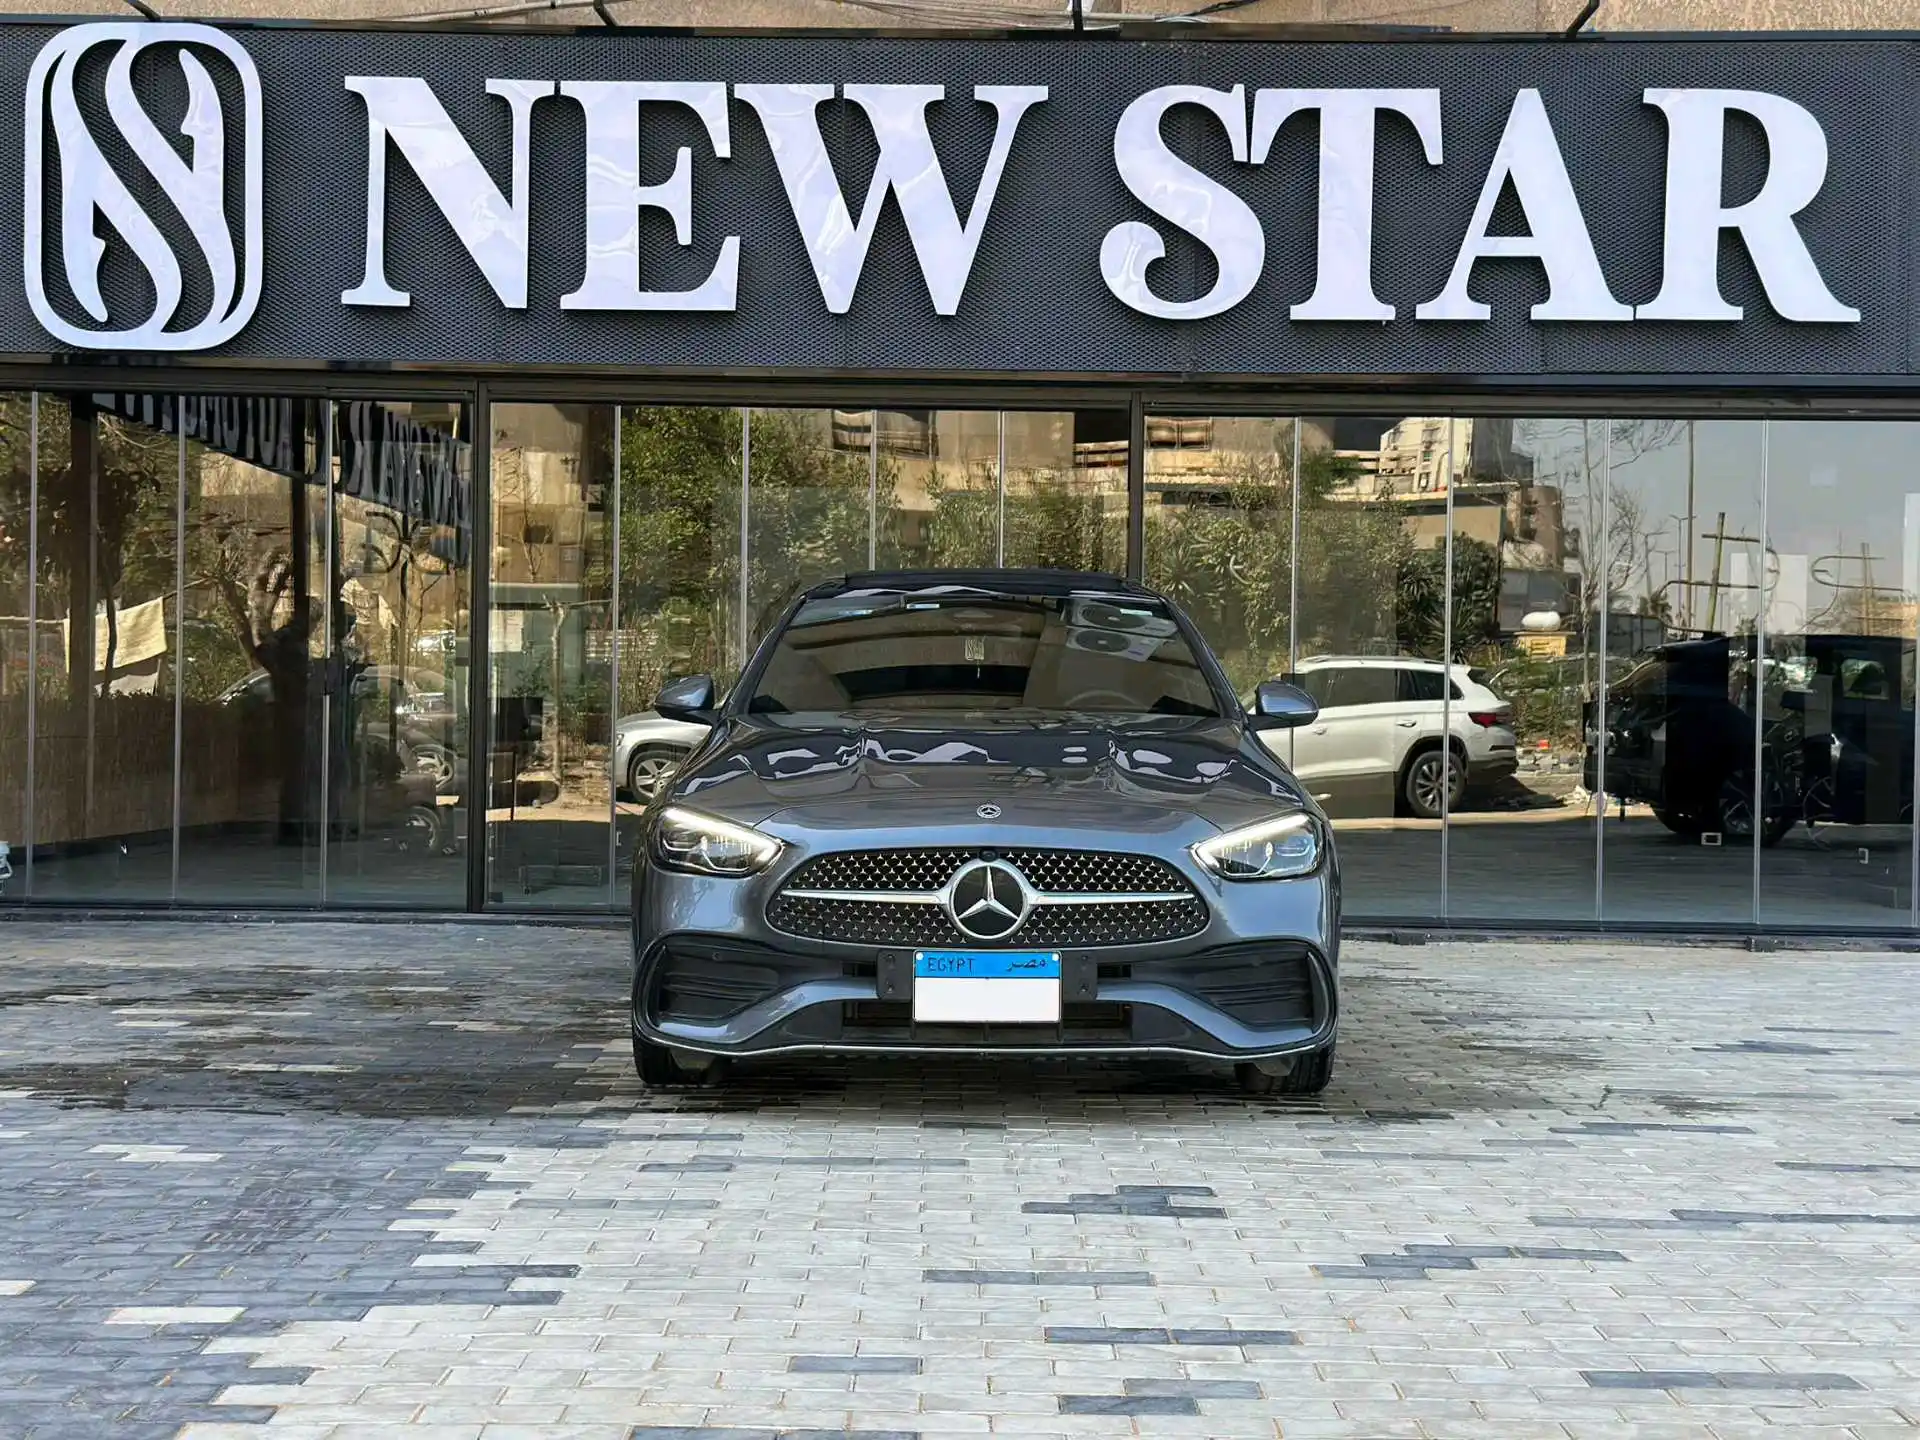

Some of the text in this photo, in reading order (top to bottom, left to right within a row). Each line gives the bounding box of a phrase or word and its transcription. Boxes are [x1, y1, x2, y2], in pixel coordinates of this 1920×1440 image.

[340, 75, 1862, 323] NEW STAR
[927, 957, 975, 972] EGYPT
[1006, 959, 1048, 972] مصر
